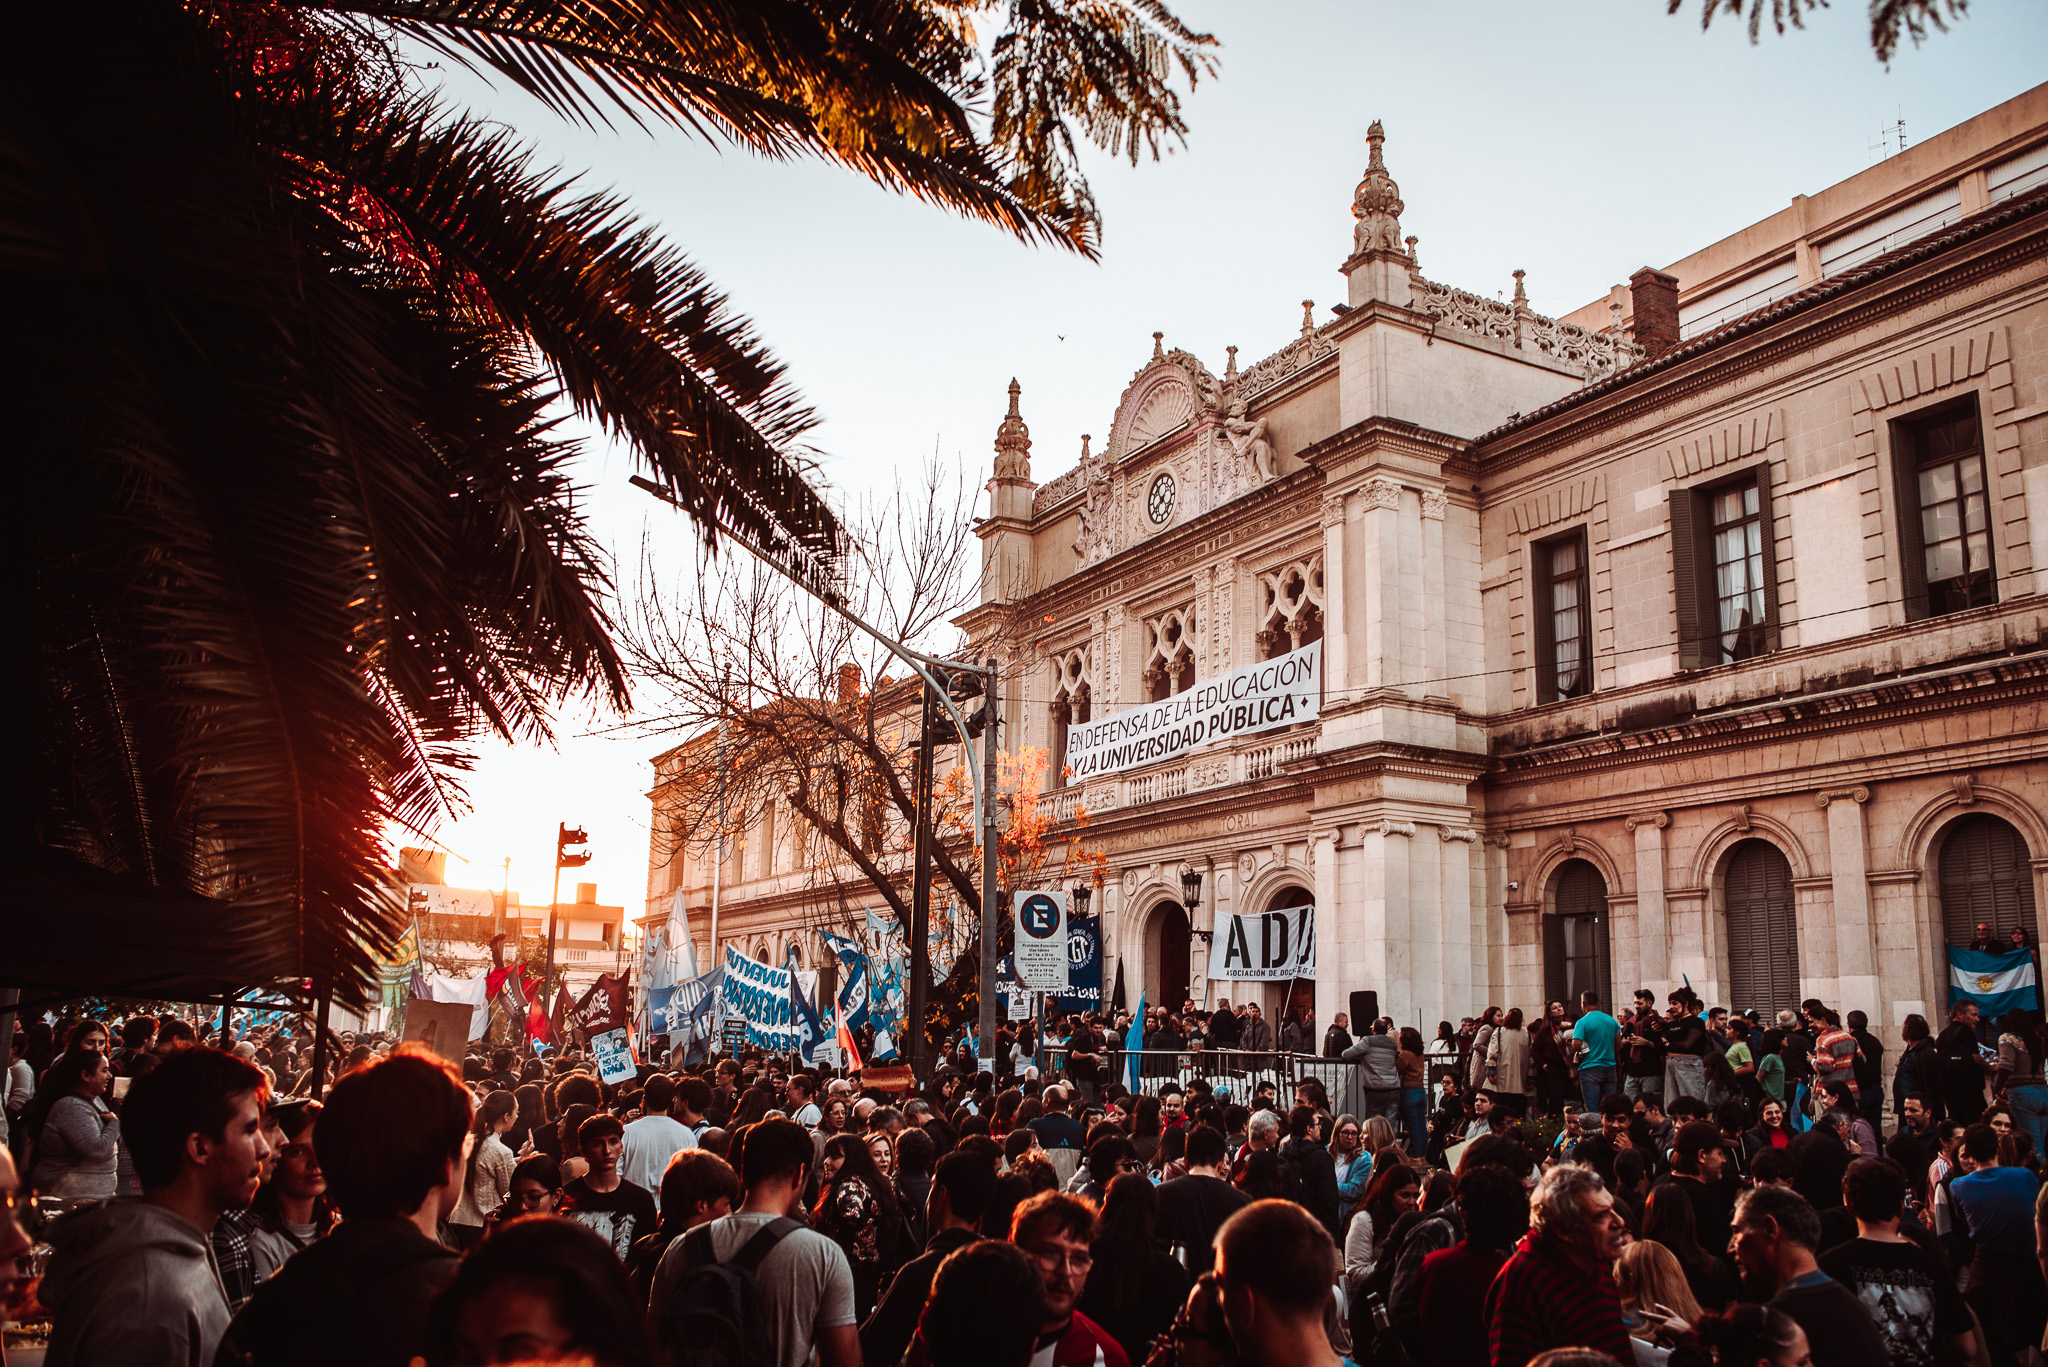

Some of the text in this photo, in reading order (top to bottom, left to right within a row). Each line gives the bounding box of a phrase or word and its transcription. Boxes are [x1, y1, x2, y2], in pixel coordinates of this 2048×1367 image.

[1069, 652, 1314, 754] EN DEFENSA DE LA EDUCACIÓN
[1074, 694, 1295, 778] Y LA UNIVERSIDAD PÚBLICA
[1033, 904, 1048, 928] E
[1224, 908, 1316, 968] ADU
[1226, 968, 1266, 977] ASOCIACIÓN
